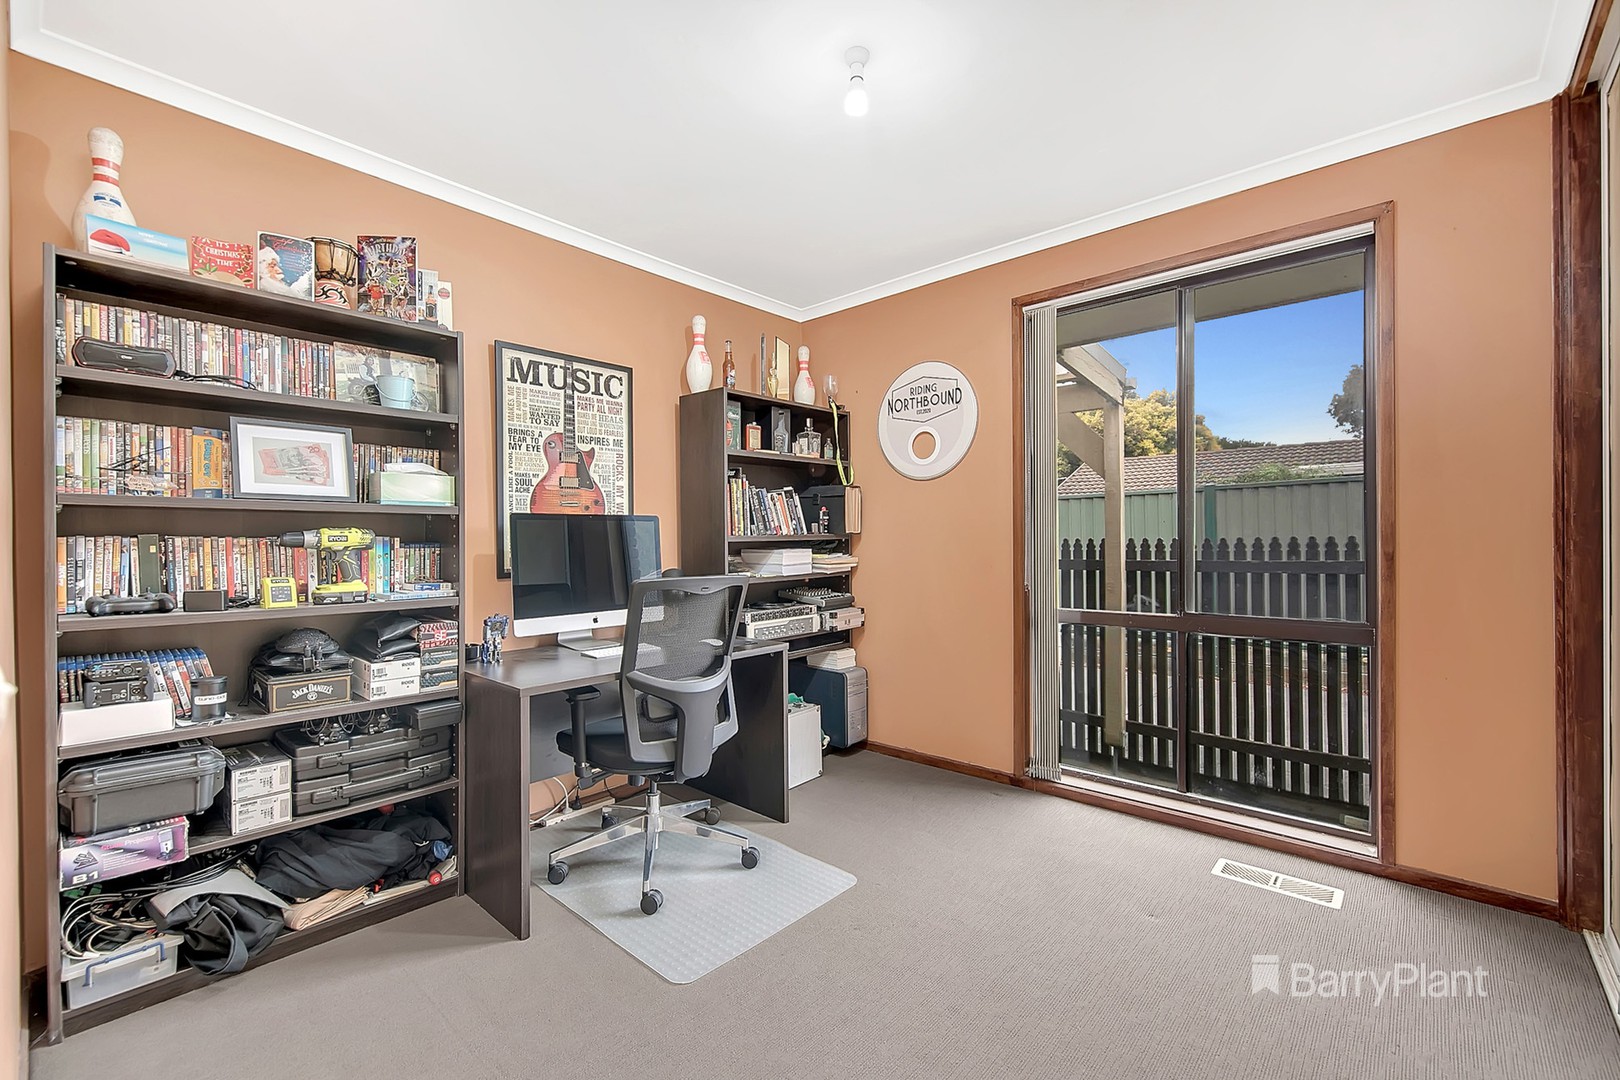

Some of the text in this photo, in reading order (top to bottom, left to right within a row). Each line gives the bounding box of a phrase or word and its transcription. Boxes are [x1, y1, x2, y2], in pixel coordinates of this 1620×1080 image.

[206, 247, 240, 258] CHRISTMAS
[216, 259, 233, 267] TIME
[506, 356, 624, 400] MUSIC
[910, 383, 938, 396] RIDING
[577, 395, 595, 404] MAKES
[887, 387, 963, 416] NORTHBOUND
[577, 402, 624, 416] PARTY ALL NIGHT
[529, 411, 561, 421] WANTED
[598, 414, 624, 425] HEALS
[508, 428, 535, 437] BRINGS
[508, 435, 540, 445] TEAR TO
[577, 435, 624, 448] INSPIRES ME
[308, 446, 321, 454] 20
[508, 443, 541, 453] MY EYE
[204, 439, 214, 478] FAMILY GUY
[616, 453, 625, 482] ROCKS
[515, 478, 535, 488] SOUL
[598, 475, 612, 485] THE
[616, 485, 625, 499] MY
[164, 676, 180, 706] LAWLESS
[176, 680, 186, 698] snatch
[292, 683, 334, 699] JACK DANIEL'S
[72, 870, 100, 885] B1
